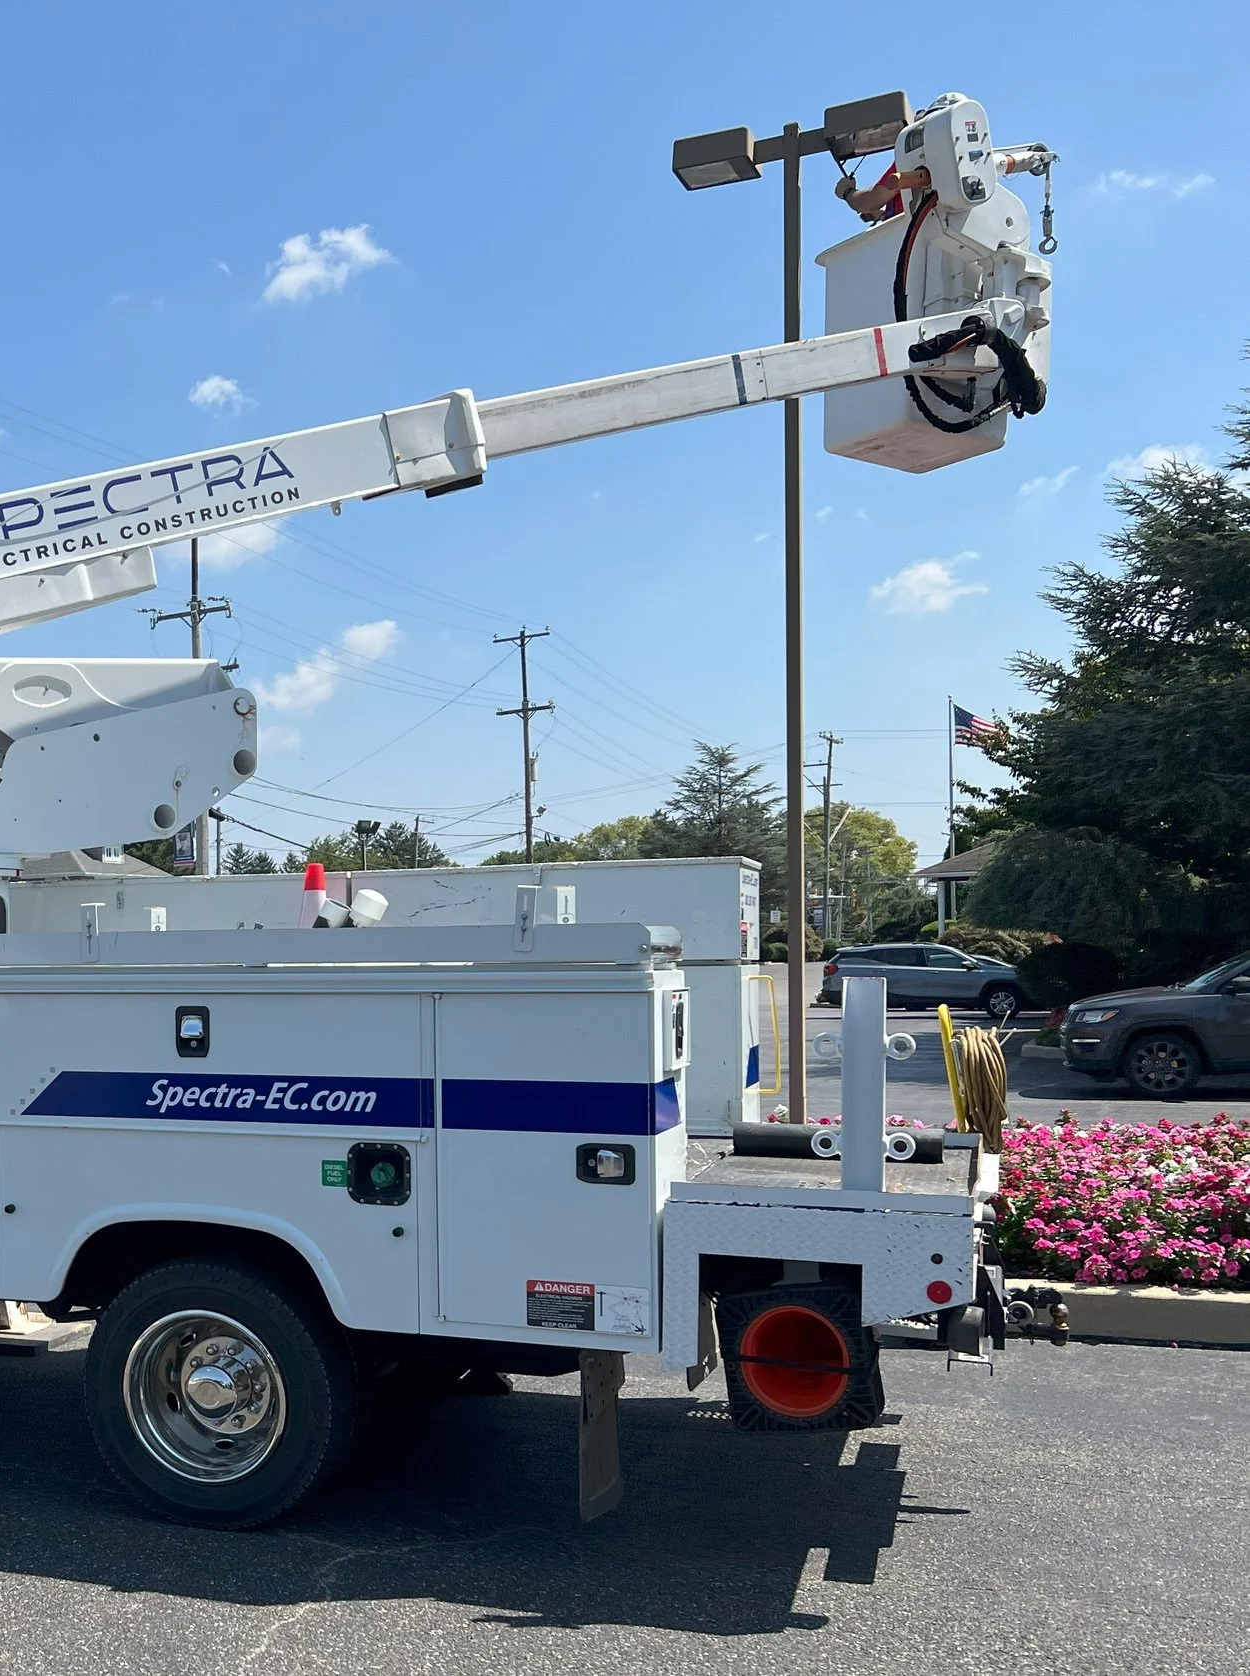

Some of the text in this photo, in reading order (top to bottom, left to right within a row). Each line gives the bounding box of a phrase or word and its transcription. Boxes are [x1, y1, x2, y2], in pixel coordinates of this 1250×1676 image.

[119, 487, 300, 540] CONSTRUCTION
[146, 1079, 377, 1113] Spectra-EC.com
[545, 1283, 590, 1295] DANGER
